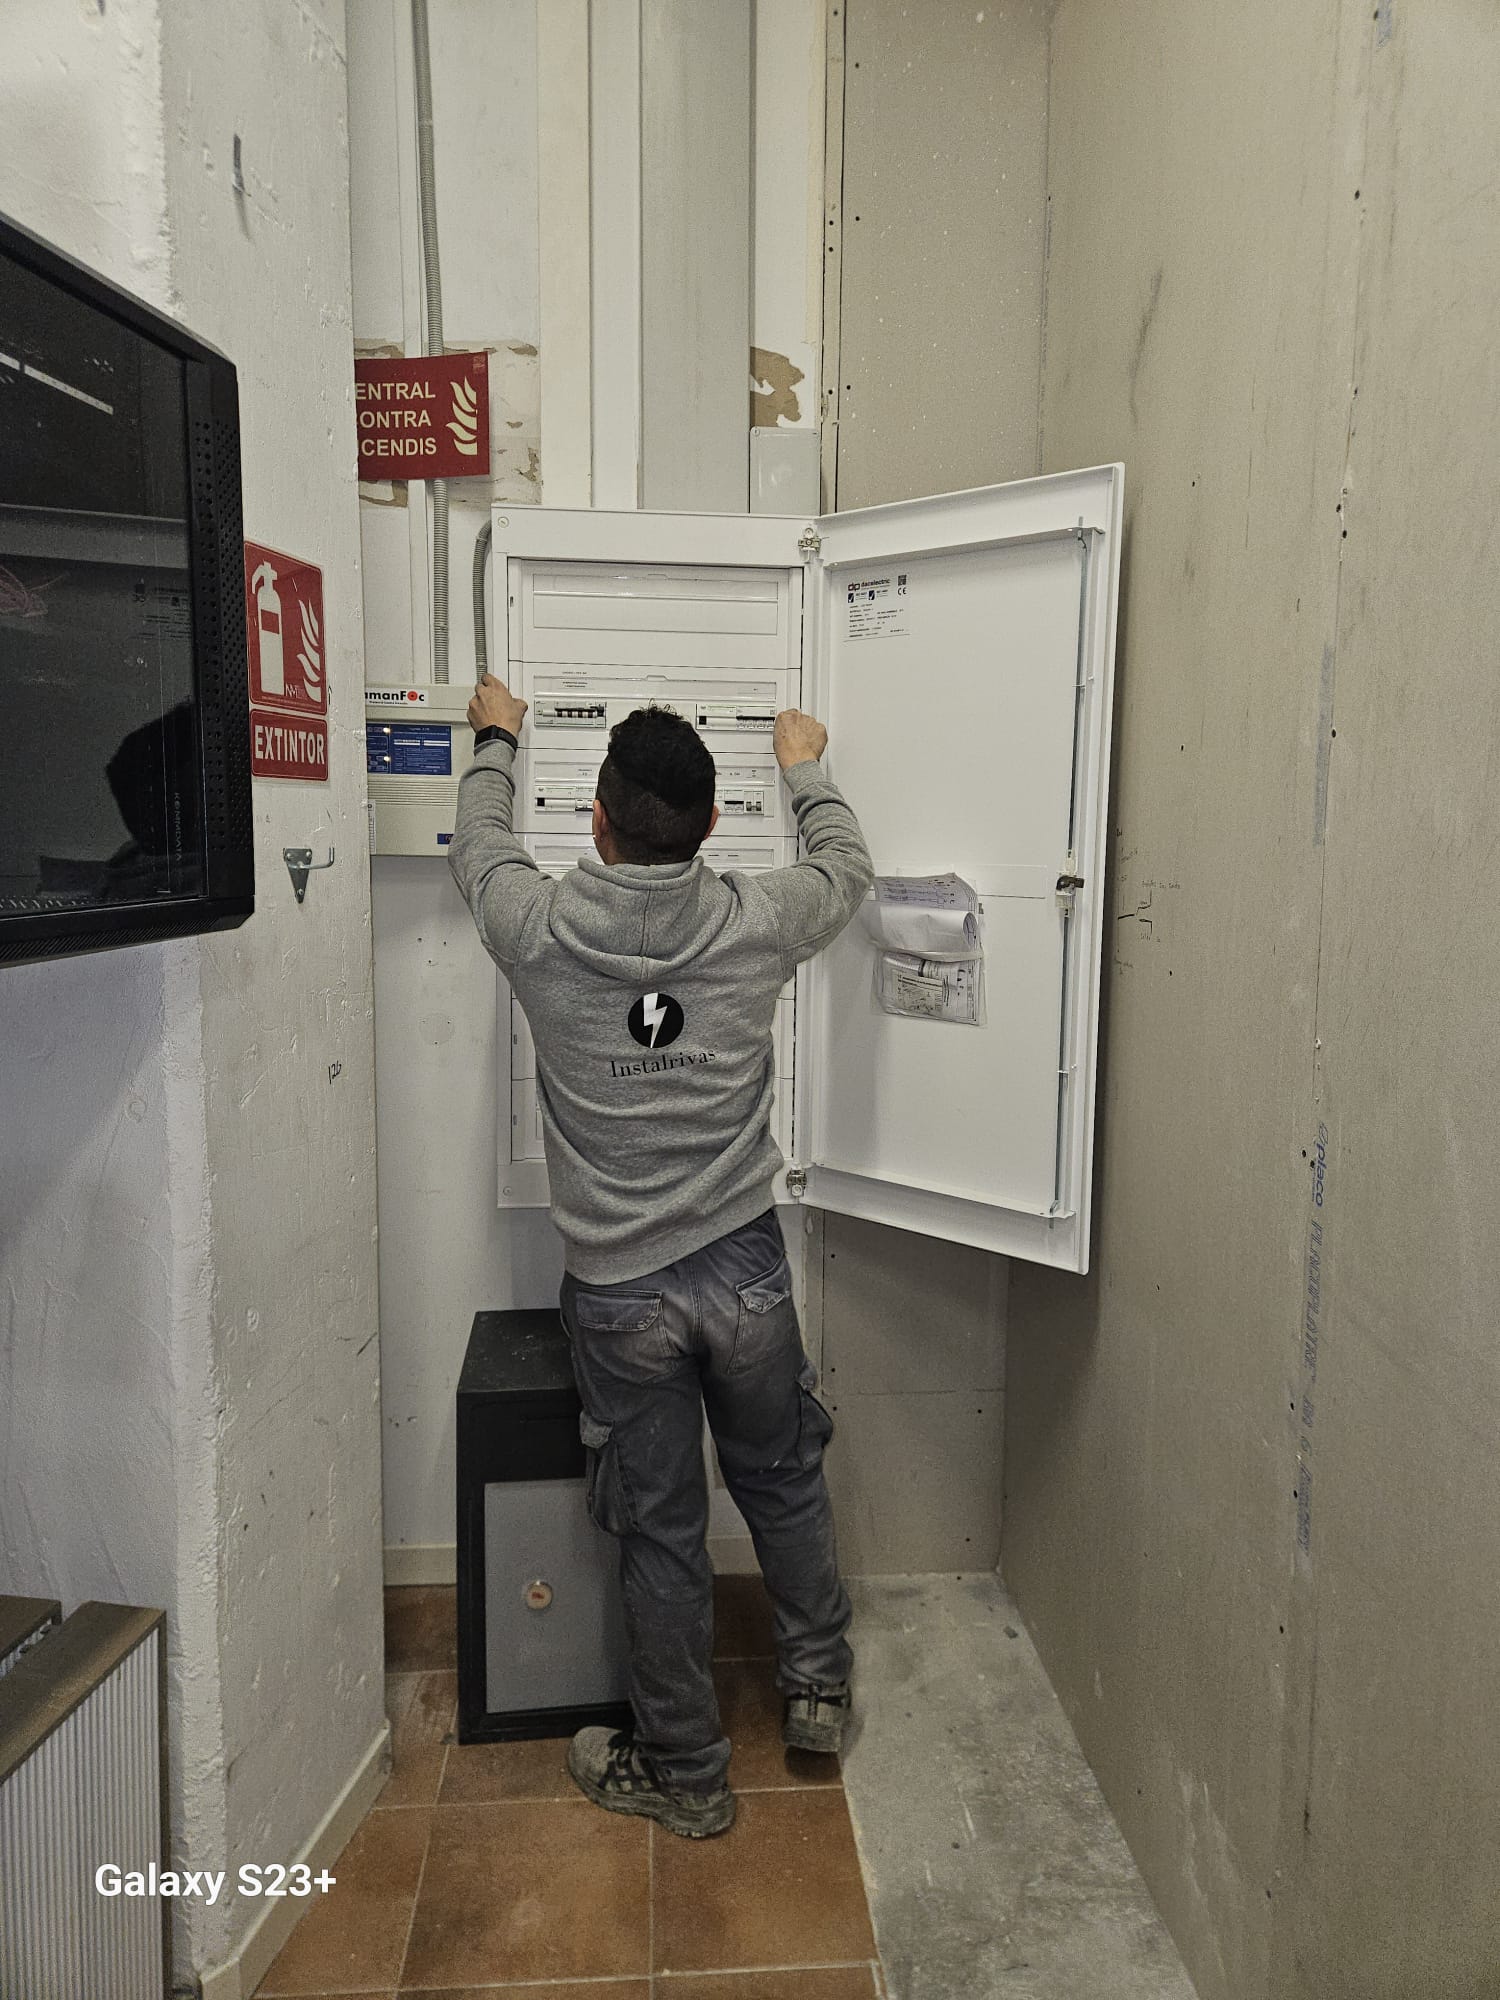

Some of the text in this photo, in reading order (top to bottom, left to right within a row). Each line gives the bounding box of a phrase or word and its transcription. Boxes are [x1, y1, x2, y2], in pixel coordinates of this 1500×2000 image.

[355, 382, 436, 400] ENTRAL
[357, 410, 431, 428] ONTRA
[358, 437, 437, 456] CENDIS
[255, 725, 325, 765] EXTINTOR
[609, 1049, 716, 1078] Instalrivas
[1315, 1143, 1327, 1208] placo
